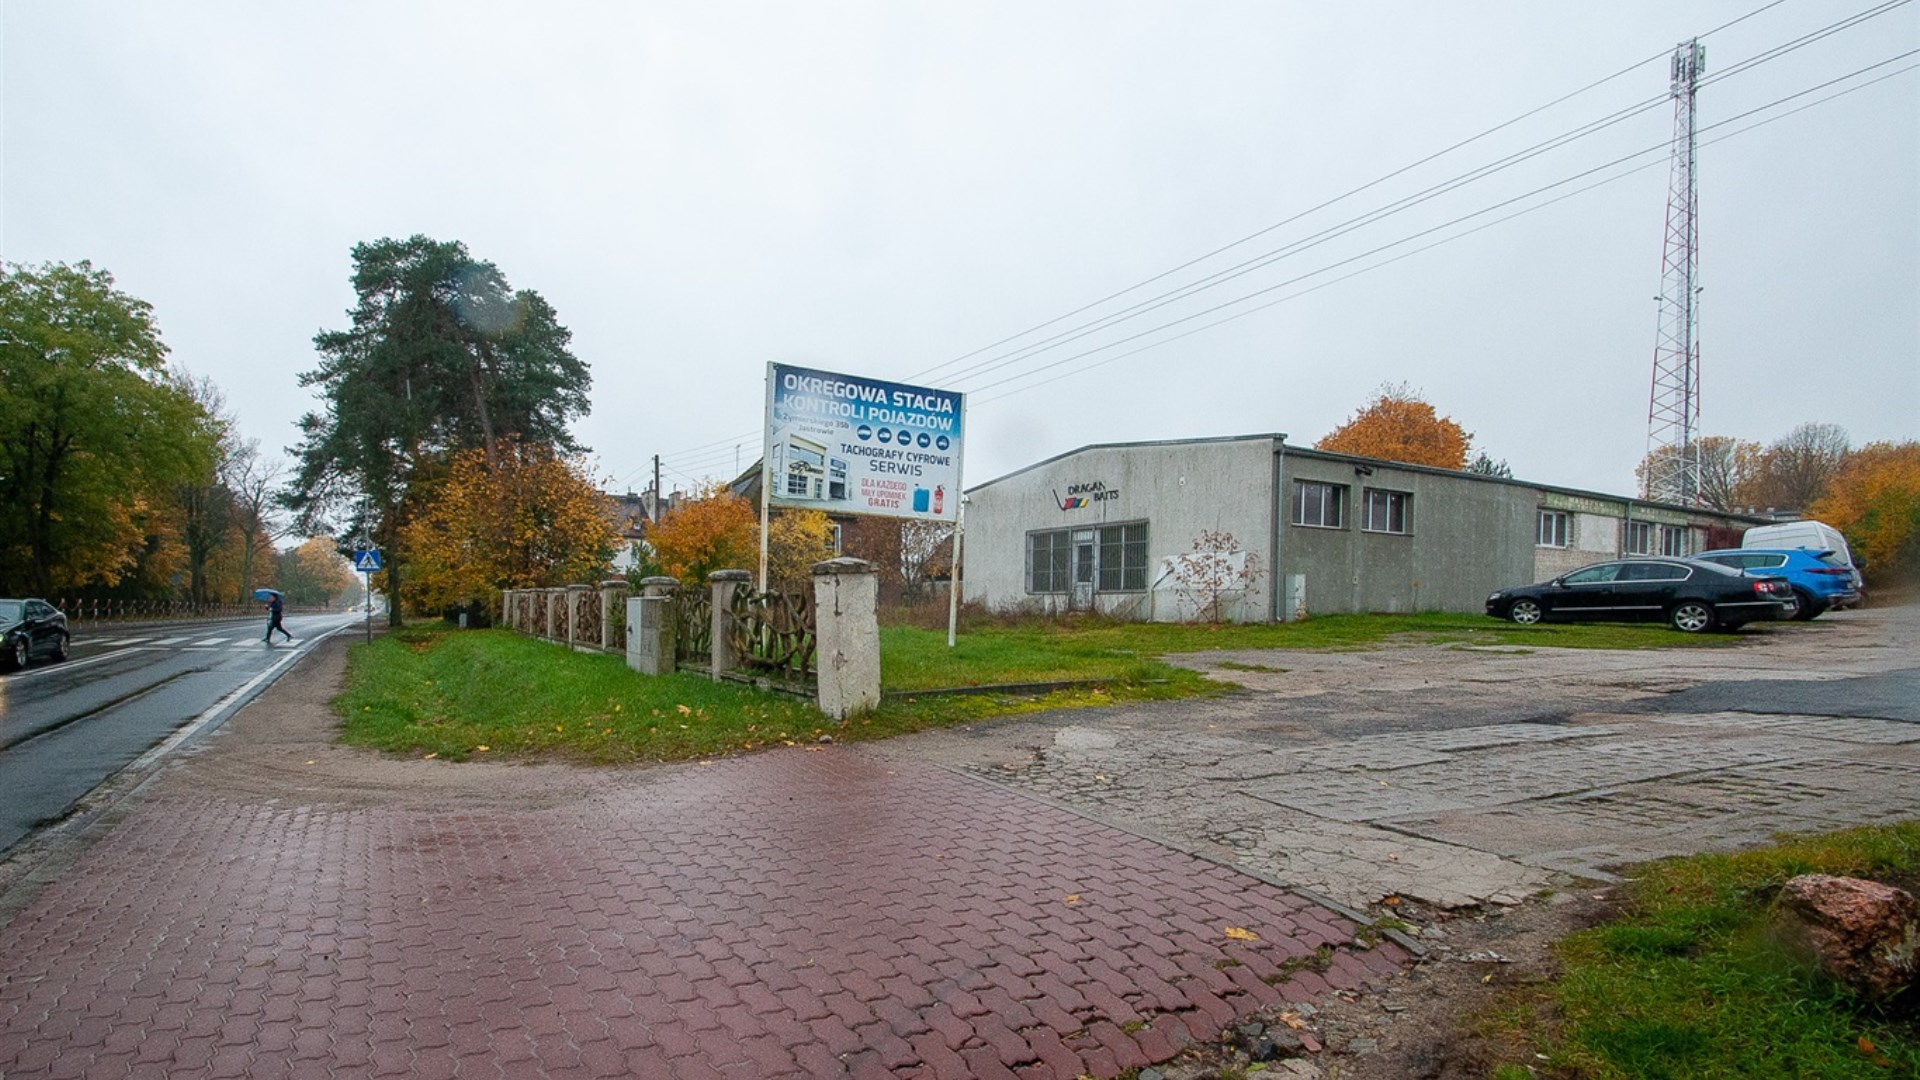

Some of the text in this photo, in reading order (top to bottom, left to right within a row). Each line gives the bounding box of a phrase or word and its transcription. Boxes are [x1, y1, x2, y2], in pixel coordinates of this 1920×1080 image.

[785, 374, 953, 414] OKRĘGOWA STACJA
[783, 394, 953, 431] KONTROLI POJAZDÓW
[798, 424, 834, 435] Jastrowie
[840, 443, 951, 466] TACHOGRAFY CYFROWE
[869, 459, 923, 476] SERWIS
[861, 478, 875, 488] DLA
[1068, 481, 1105, 495] DRAGAN
[868, 497, 899, 508] GRATIS
[1094, 489, 1119, 502] BAITS
